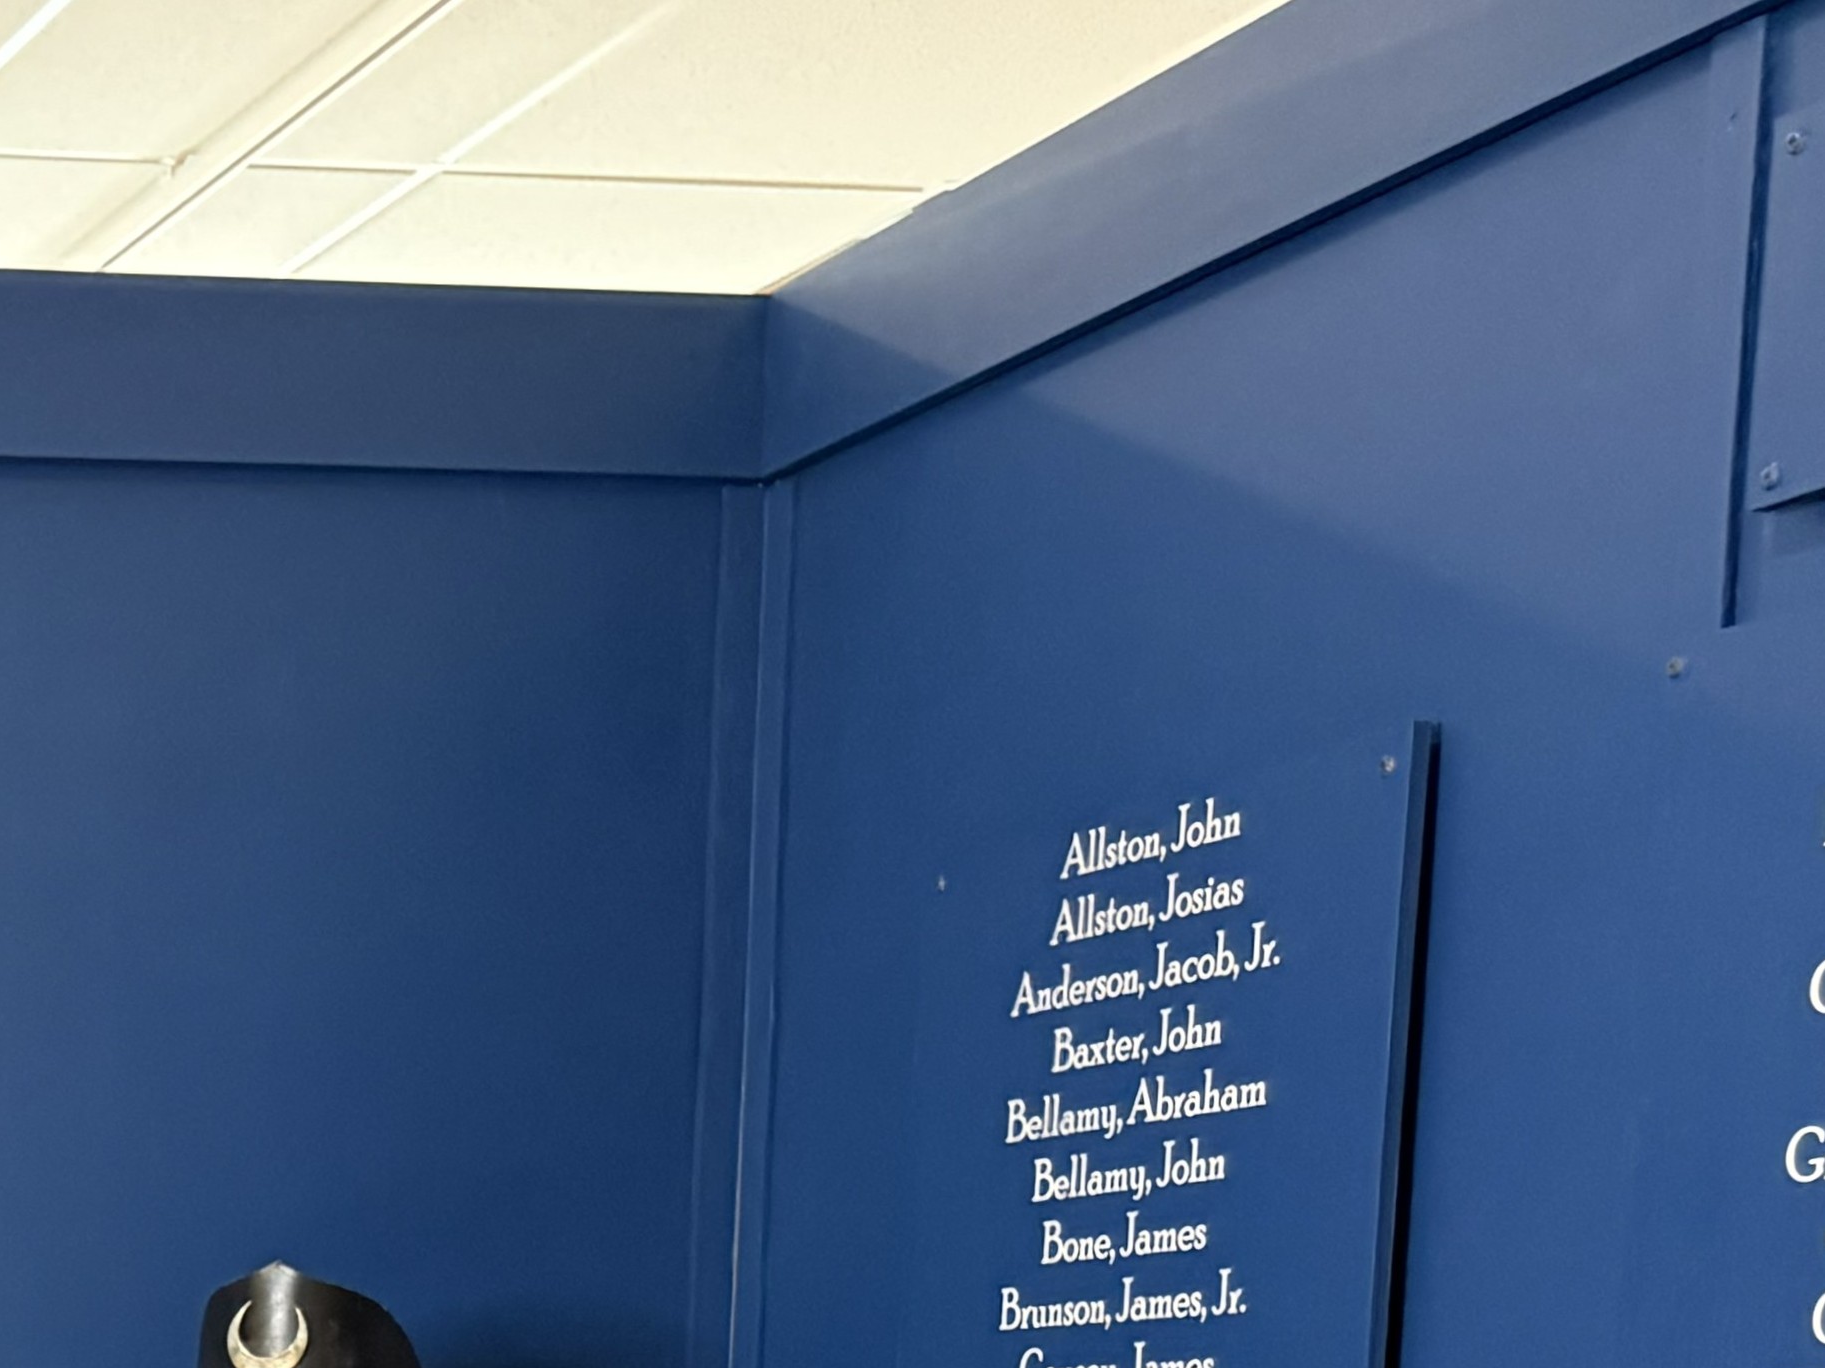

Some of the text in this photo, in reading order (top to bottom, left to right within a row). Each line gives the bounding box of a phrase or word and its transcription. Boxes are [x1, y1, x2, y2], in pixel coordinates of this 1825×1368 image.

[1059, 797, 1241, 880] Allston, John
[1049, 872, 1245, 946] Allston, Josias
[1010, 920, 1281, 1018] Anderson, Jacob, Jr.
[1051, 1003, 1222, 1073] Baxter, John
[1005, 1068, 1267, 1144] Bellamy, Abraham
[1031, 1137, 1226, 1203] Bellamy, John
[1040, 1210, 1208, 1265] Bone, James
[998, 1267, 1247, 1331] Brunson, James, Jr.
